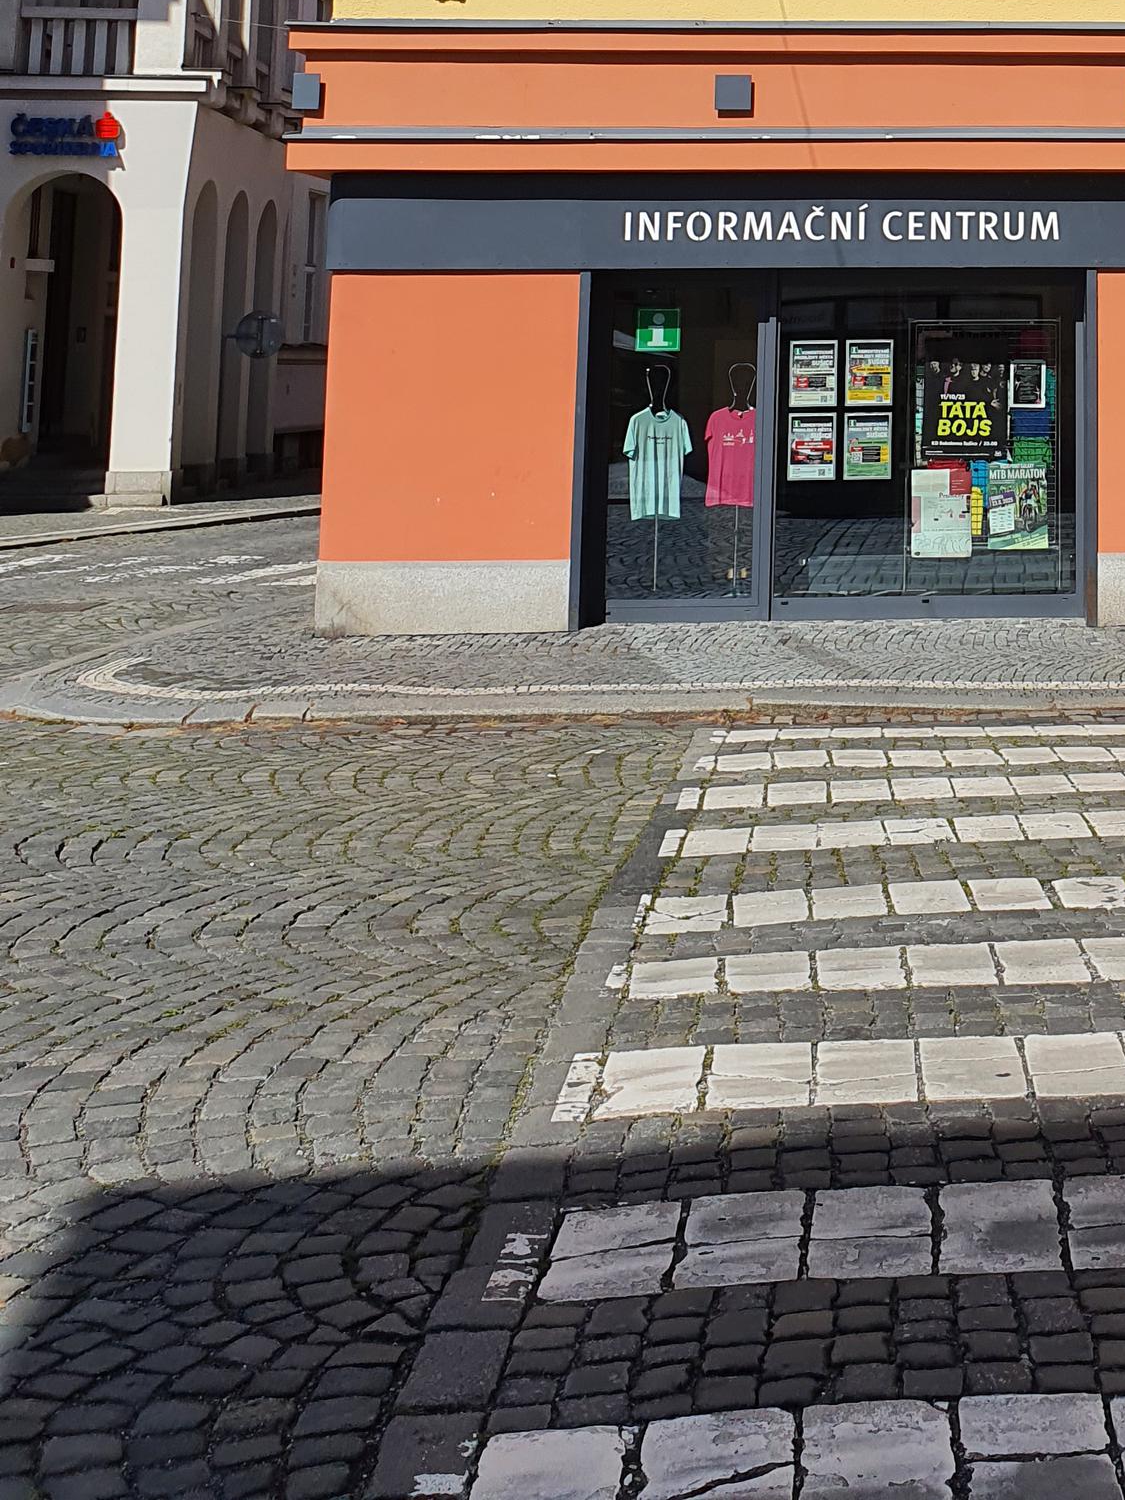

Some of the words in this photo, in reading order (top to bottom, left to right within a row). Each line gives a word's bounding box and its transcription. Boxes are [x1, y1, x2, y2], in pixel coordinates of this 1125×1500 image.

[623, 203, 870, 242] INFORMAČNÍ
[881, 210, 1060, 242] CENTRUM
[939, 401, 988, 419] TATA
[937, 419, 993, 437] BOJS
[989, 469, 1007, 480] MTB
[1007, 468, 1046, 480] MARATON
